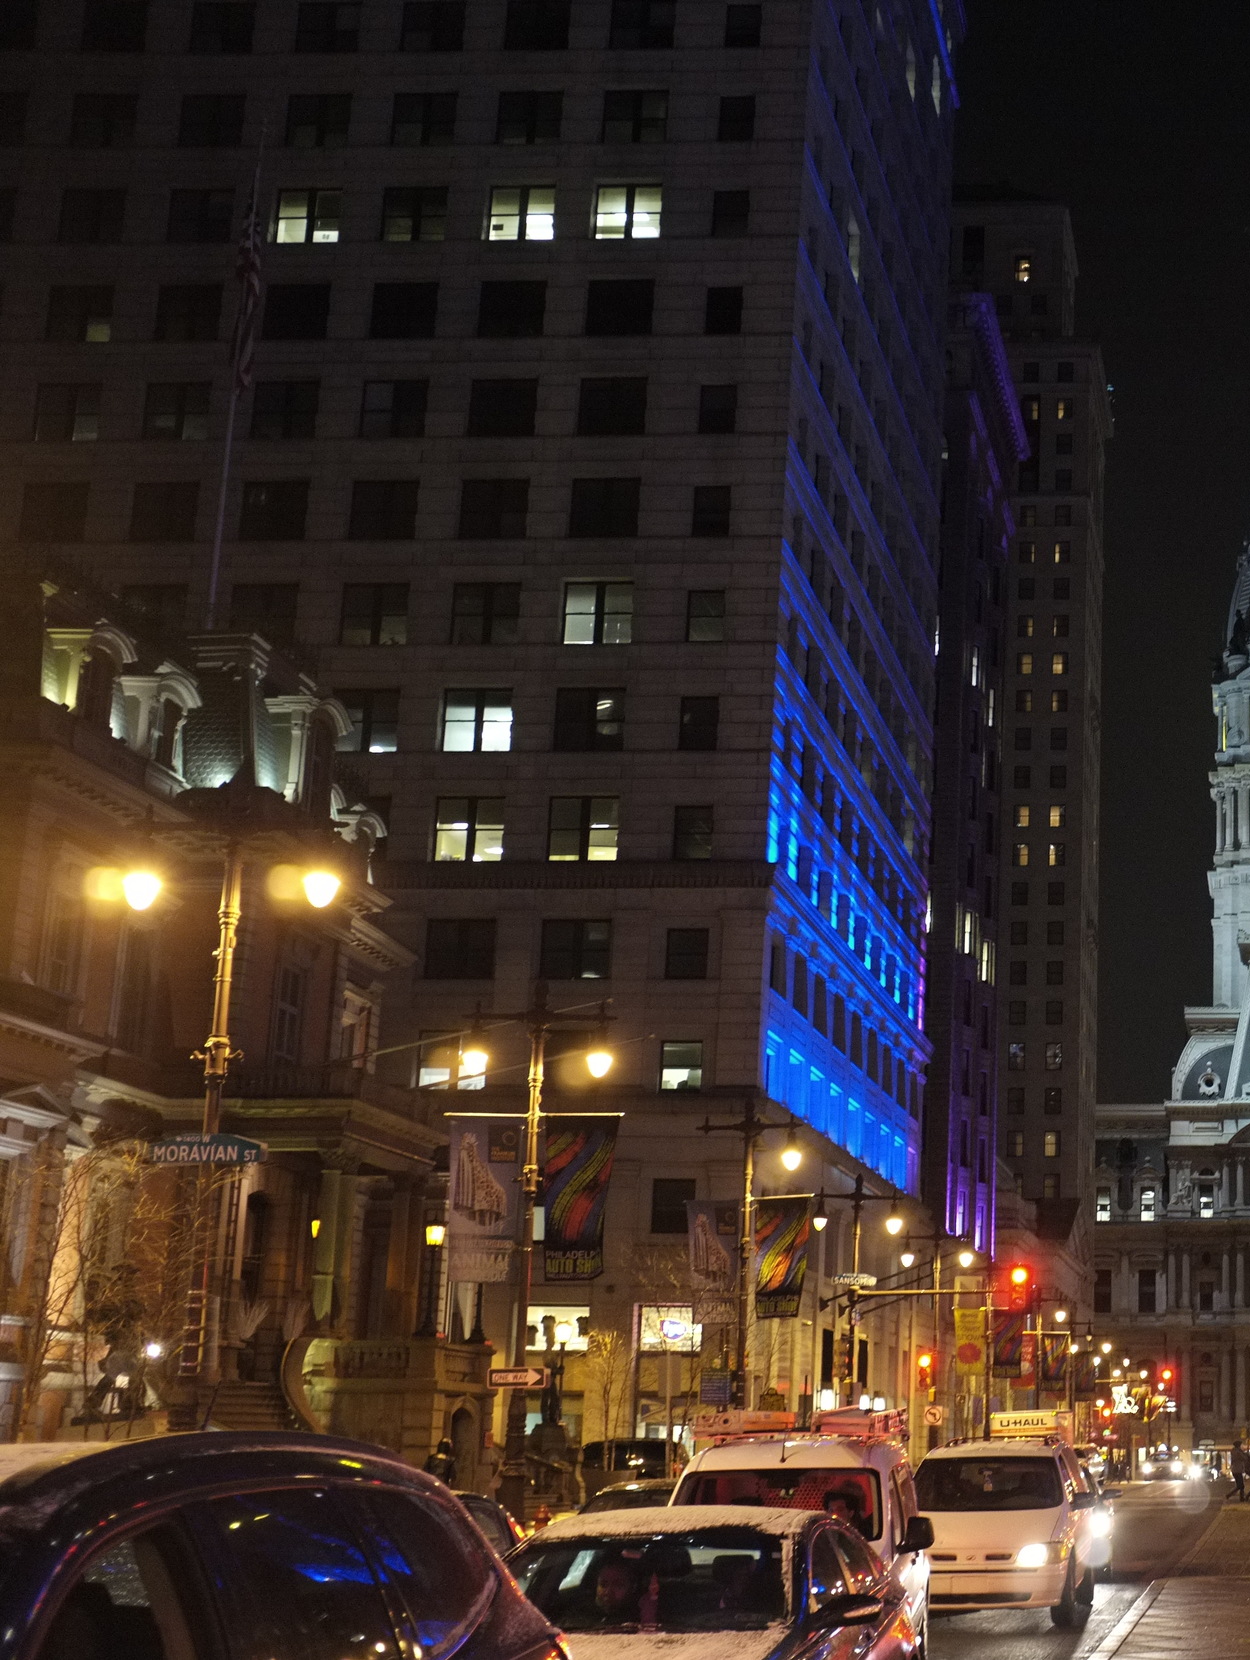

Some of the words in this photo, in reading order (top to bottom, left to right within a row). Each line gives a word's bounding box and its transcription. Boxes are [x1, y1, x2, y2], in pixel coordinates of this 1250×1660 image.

[153, 1144, 238, 1161] MORAVIAN
[243, 1149, 257, 1161] ST
[546, 1258, 573, 1273] AUTO
[494, 1374, 509, 1382] ONE
[512, 1373, 529, 1381] WAY
